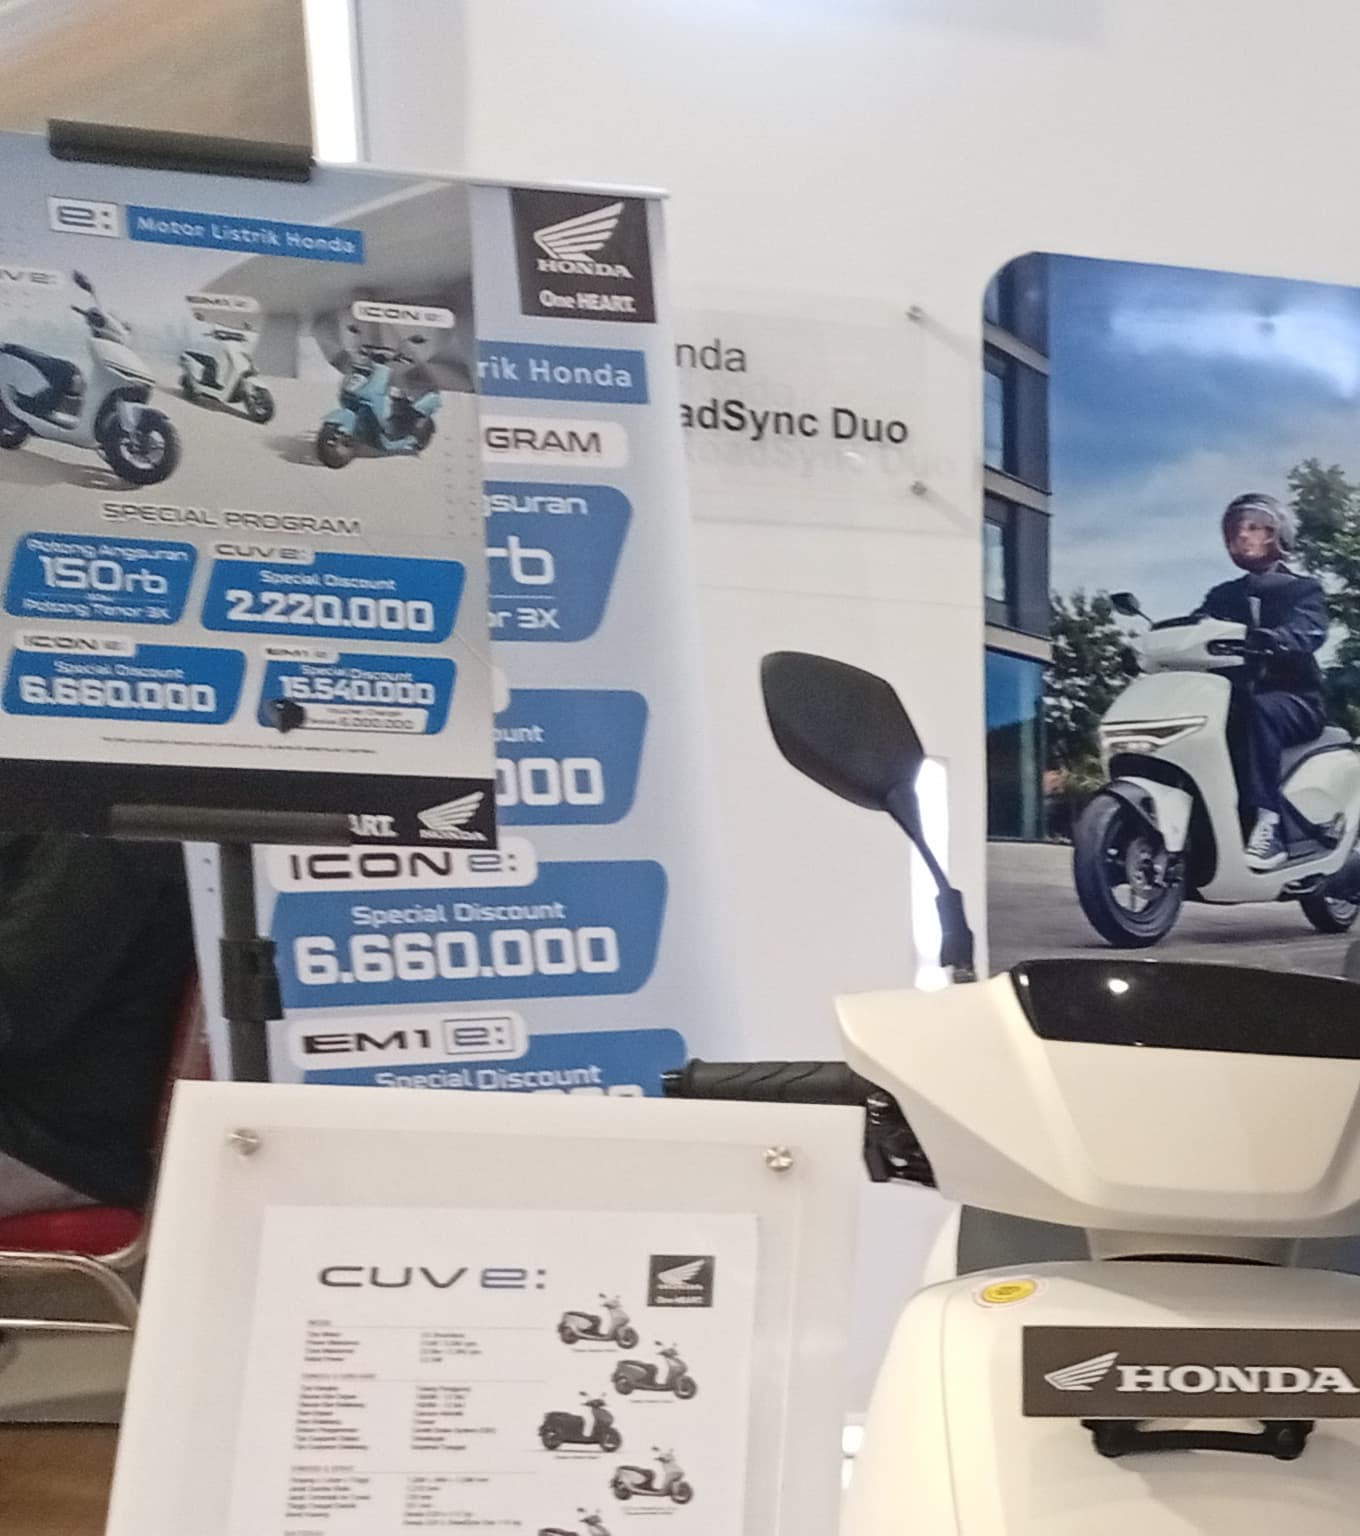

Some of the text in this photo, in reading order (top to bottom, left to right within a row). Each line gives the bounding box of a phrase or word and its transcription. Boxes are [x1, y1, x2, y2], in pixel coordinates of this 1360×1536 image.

[136, 215, 204, 238] Motor
[211, 222, 280, 247] Listrik
[285, 231, 356, 254] Honda
[536, 257, 633, 280] HONDA
[539, 288, 574, 309] One
[675, 338, 747, 373] nda
[528, 357, 633, 388] Honda
[832, 406, 909, 445] Duo
[484, 426, 603, 454] GRAM
[101, 502, 361, 537] SPECIAL PROGRAM
[214, 543, 276, 558] CUV
[39, 554, 169, 595] 150rb
[258, 568, 397, 592] Special Discount
[224, 588, 435, 633] 2.220.000
[516, 606, 560, 630] 3X
[22, 634, 99, 650] ICON
[52, 659, 185, 680] Special Discount
[18, 674, 217, 713] 6.660.000
[278, 674, 436, 705] 15.540.000
[290, 849, 453, 881] ICON
[350, 900, 567, 928] Special Discount
[293, 925, 620, 986] 6.660.000
[302, 1030, 432, 1056] EM1
[374, 1065, 603, 1090] Special Discount
[318, 1264, 468, 1291] CUV
[1116, 1365, 1360, 1394] HONDA
